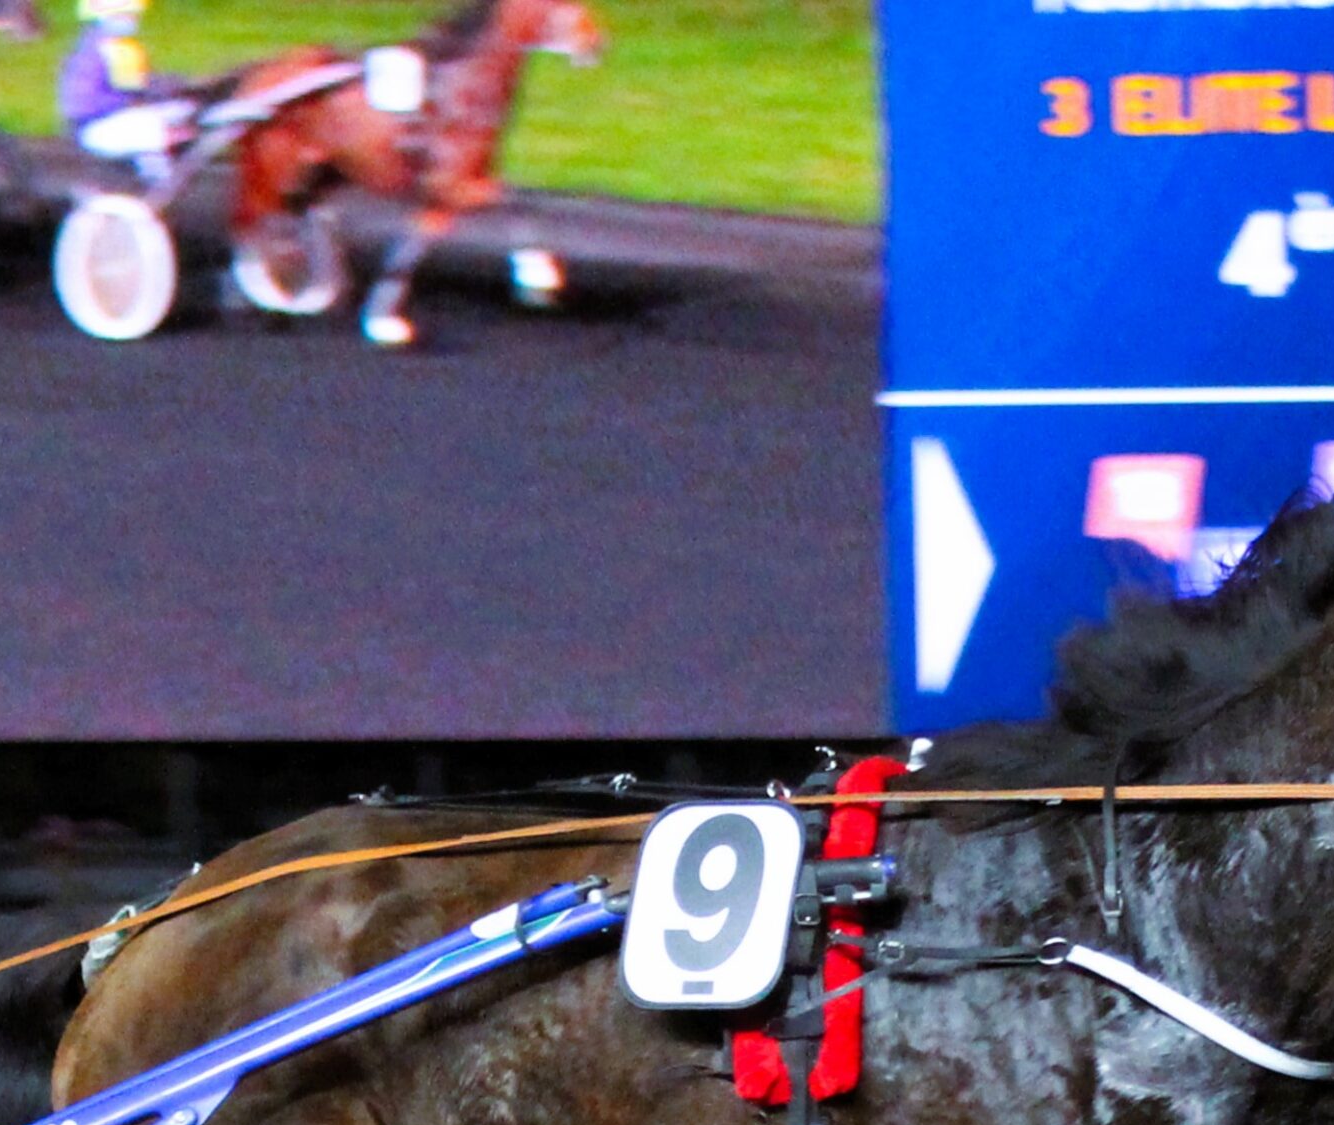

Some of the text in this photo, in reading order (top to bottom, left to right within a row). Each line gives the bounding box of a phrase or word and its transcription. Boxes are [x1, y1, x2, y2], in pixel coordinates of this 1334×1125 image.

[1040, 76, 1094, 138] 3
[1109, 70, 1303, 137] ELITE
[664, 813, 765, 973] 9
